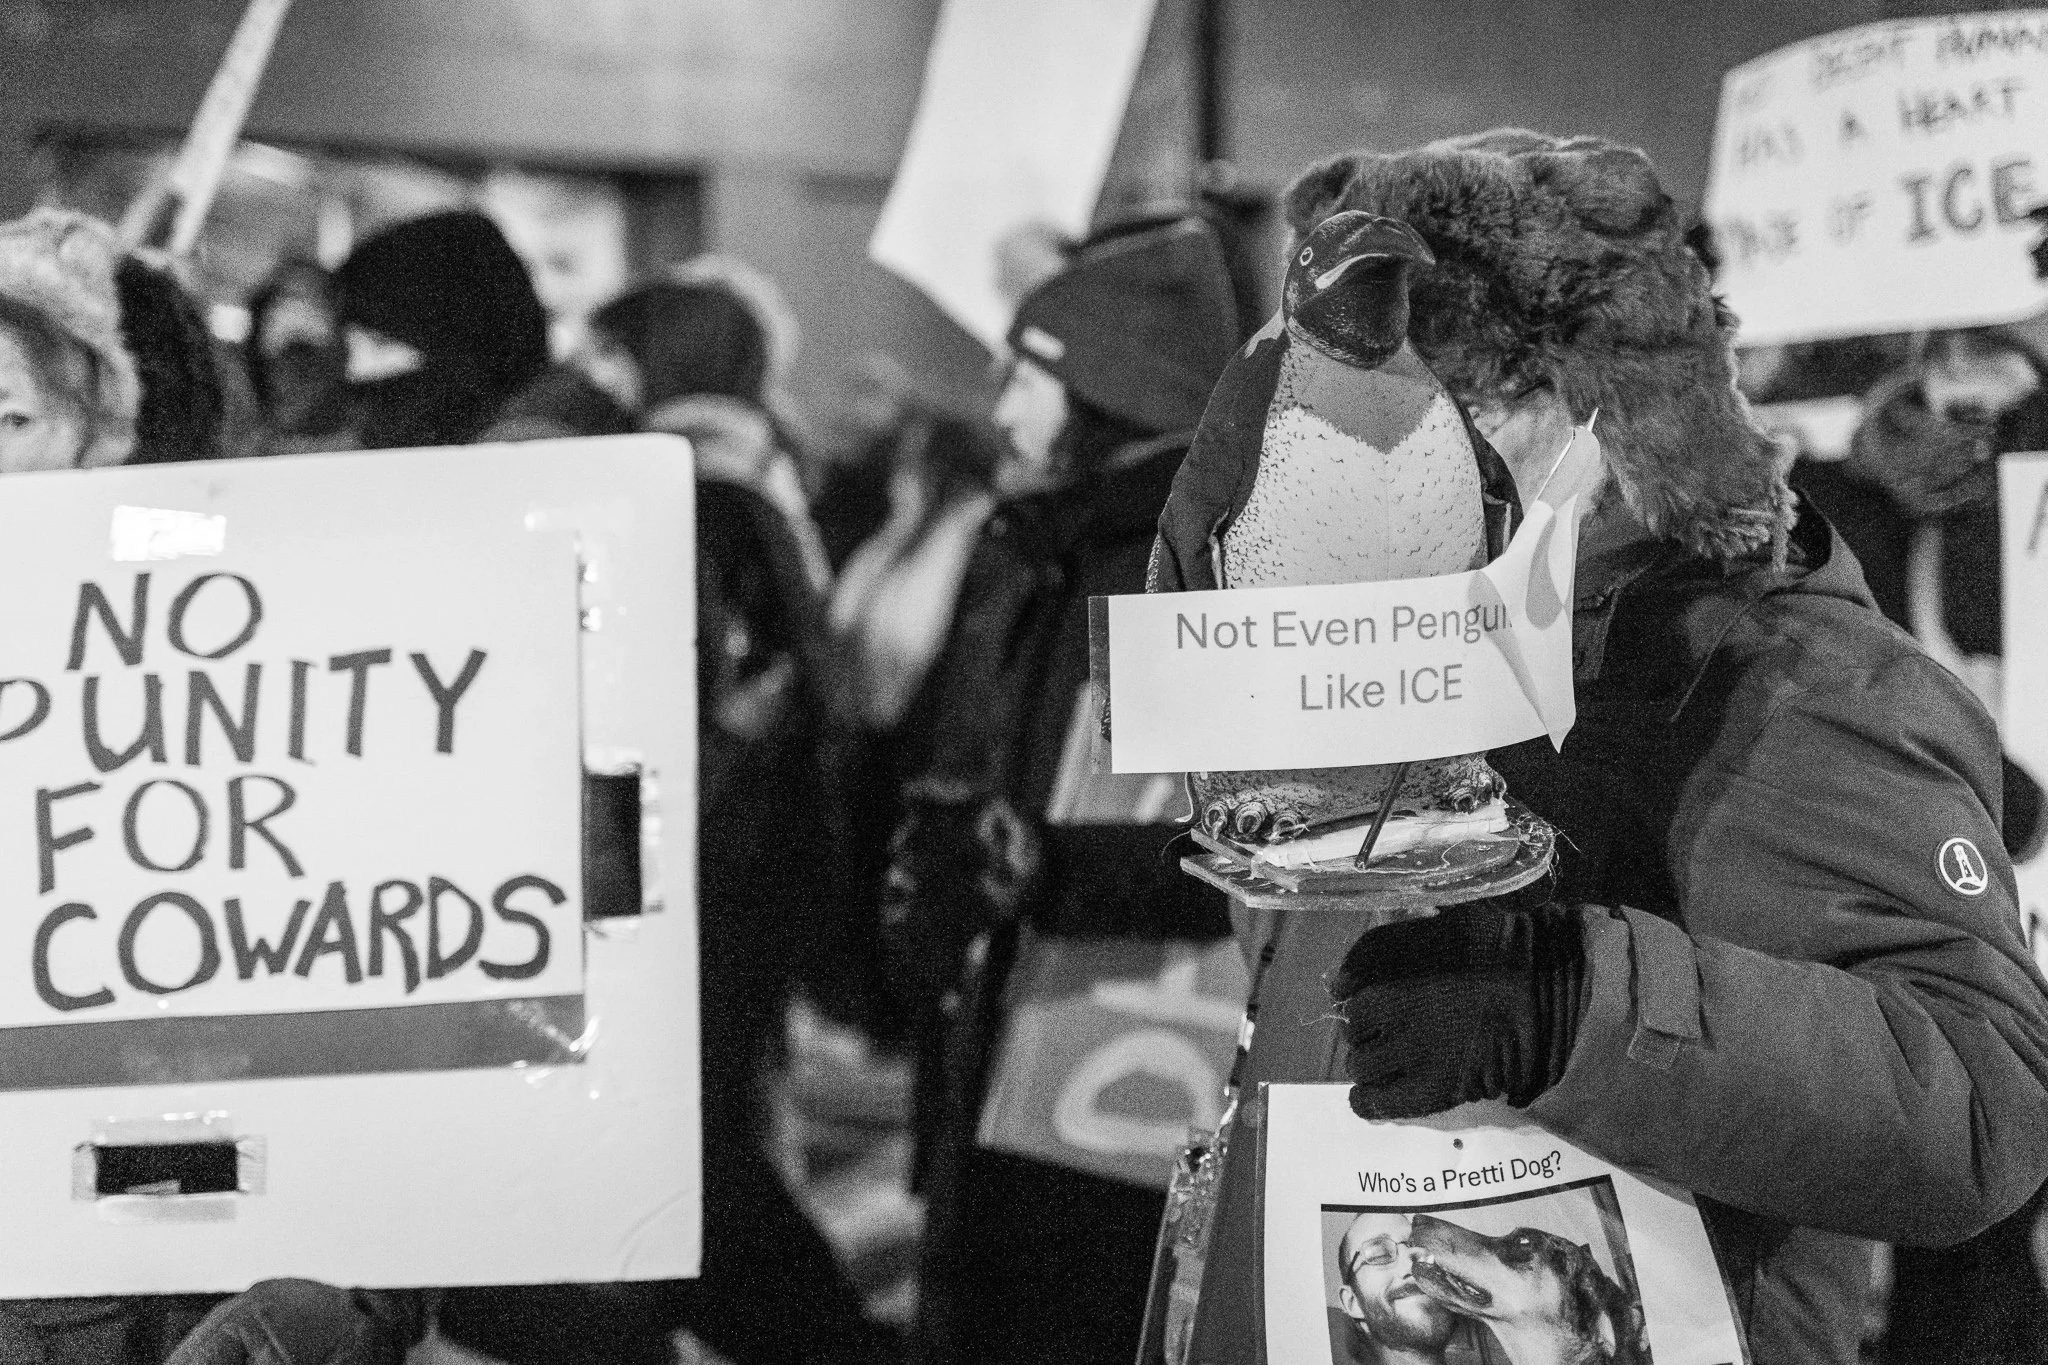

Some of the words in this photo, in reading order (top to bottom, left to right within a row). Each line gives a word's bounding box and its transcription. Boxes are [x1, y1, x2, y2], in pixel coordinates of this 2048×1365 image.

[1900, 159, 2034, 245] ICE
[66, 572, 263, 671] NO
[1176, 612, 1258, 650] Not
[1272, 611, 1376, 648] Even
[1393, 603, 1512, 644] Pengui
[1300, 672, 1385, 711] Like
[1399, 663, 1463, 706] ICE
[36, 775, 306, 895] FOR
[33, 874, 567, 1012] COWARDS
[1358, 1170, 1417, 1193] Who's
[1423, 1176, 1436, 1192] a
[1442, 1162, 1505, 1190] Pretti
[1510, 1150, 1562, 1180] Dog?
